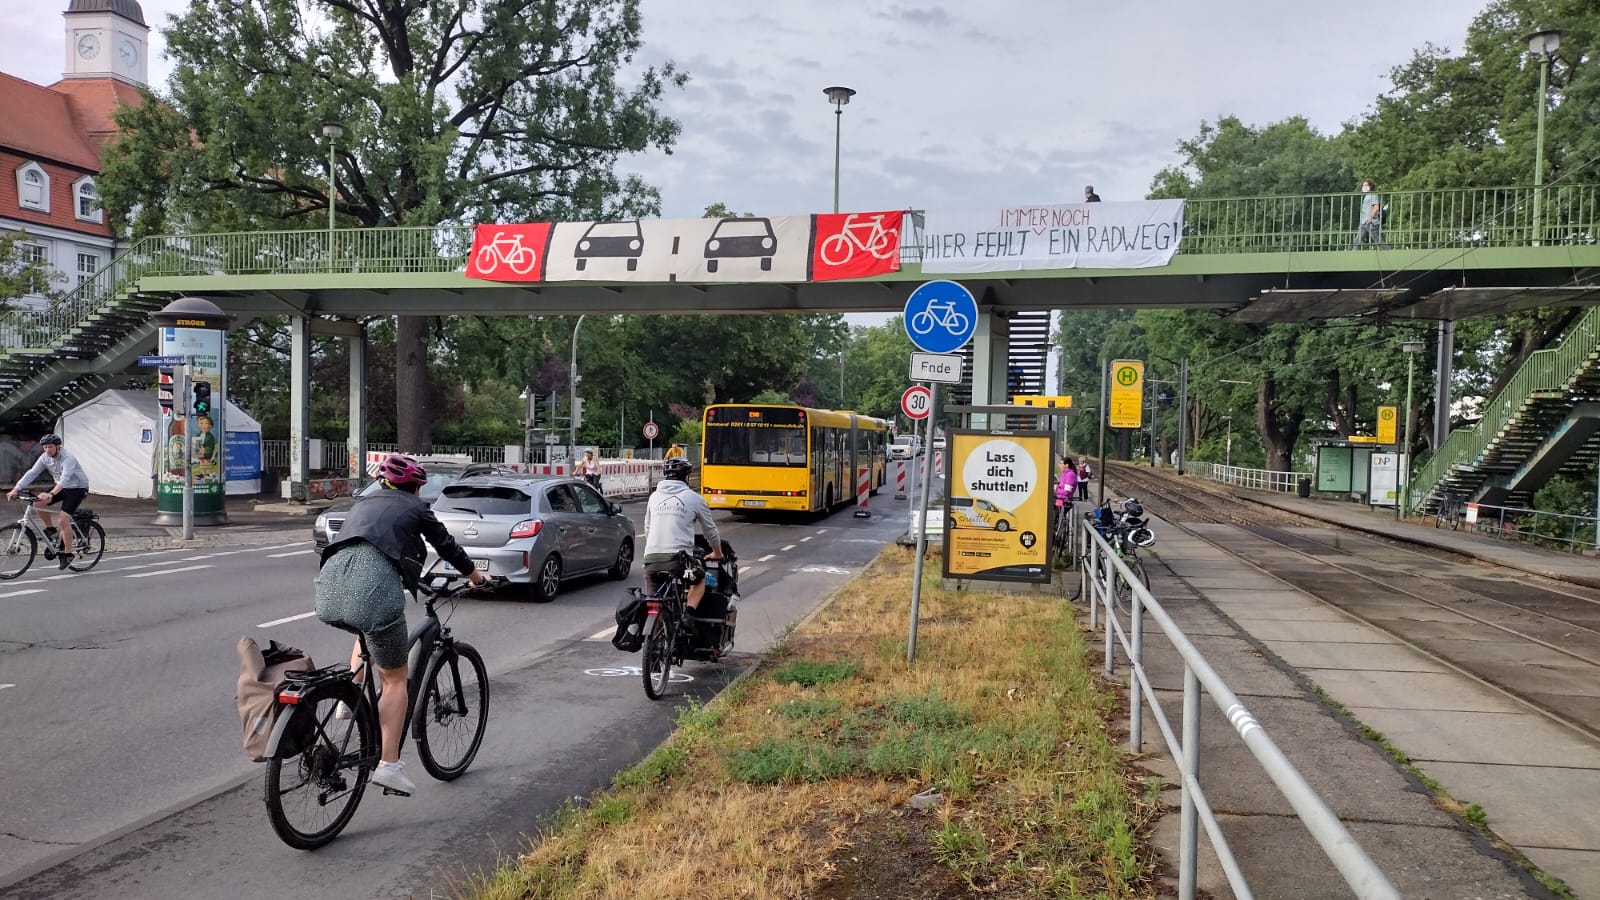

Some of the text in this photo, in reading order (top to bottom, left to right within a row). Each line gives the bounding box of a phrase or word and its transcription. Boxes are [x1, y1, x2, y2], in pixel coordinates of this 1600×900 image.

[1000, 208, 1091, 228] IMMER NOCH
[925, 221, 1179, 259] HIER FEHLT EIN RADWEG!
[1122, 370, 1133, 382] H
[911, 394, 926, 410] 30
[986, 450, 1015, 463] Lass
[987, 466, 1014, 478] dich
[971, 479, 1029, 493] shuttlen!
